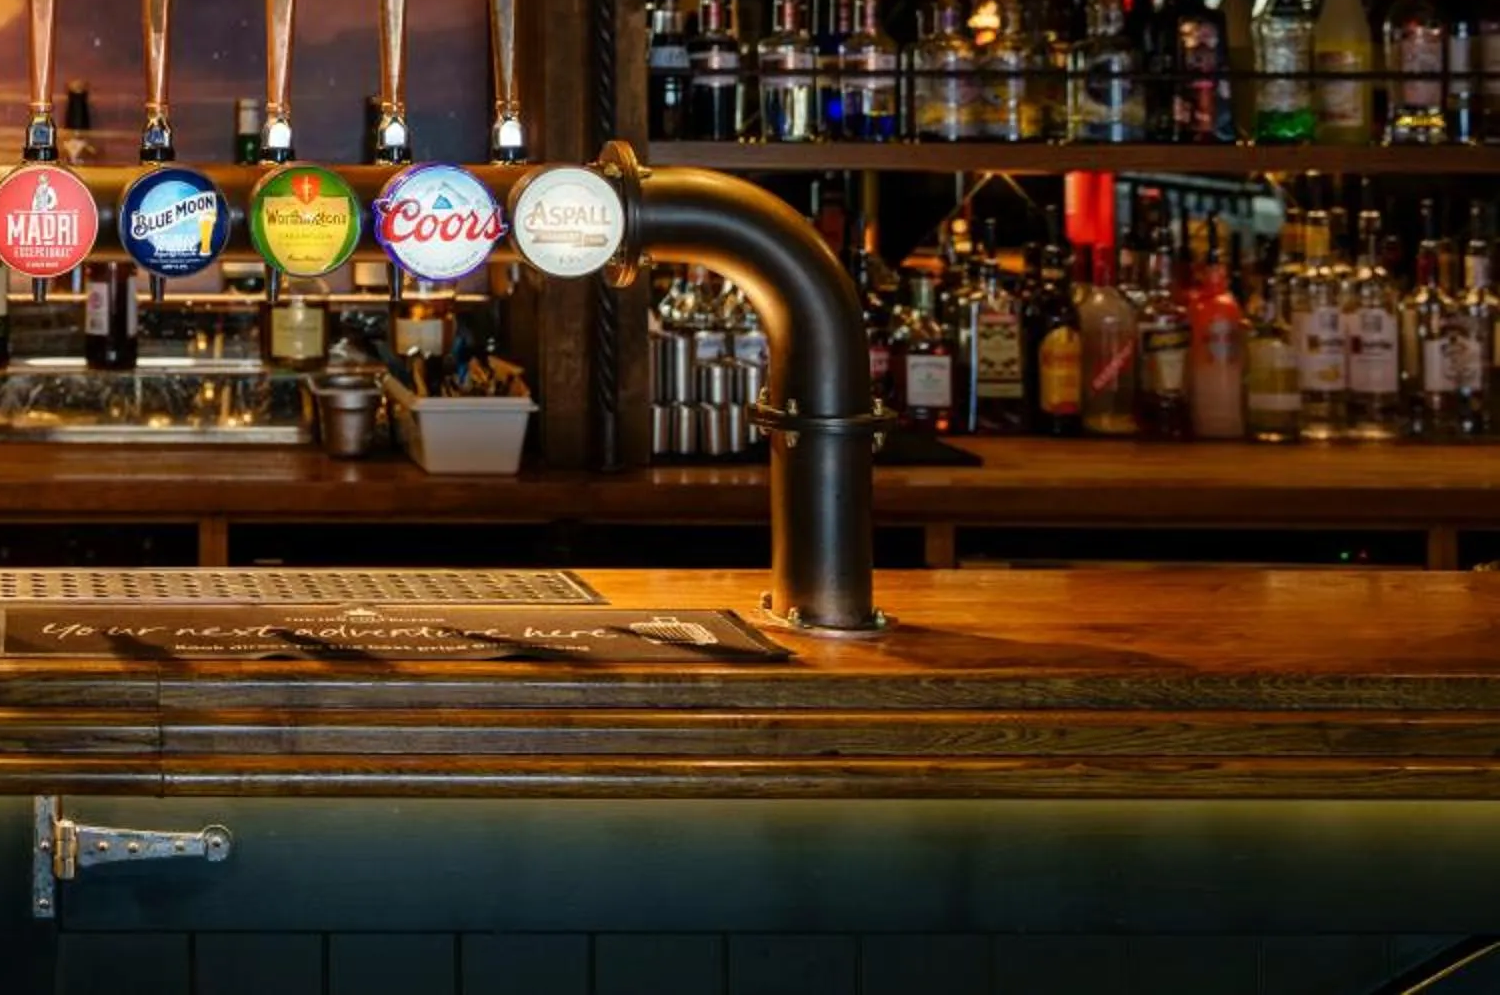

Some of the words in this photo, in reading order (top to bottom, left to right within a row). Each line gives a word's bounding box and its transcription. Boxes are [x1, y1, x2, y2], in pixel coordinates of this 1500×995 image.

[133, 210, 173, 236] BLUE
[175, 195, 215, 219] MOON
[378, 198, 503, 243] Coors
[526, 200, 612, 229] ASPALL
[41, 622, 168, 641] Your
[174, 624, 288, 638] next
[294, 625, 511, 639] adventure
[522, 626, 617, 638] here
